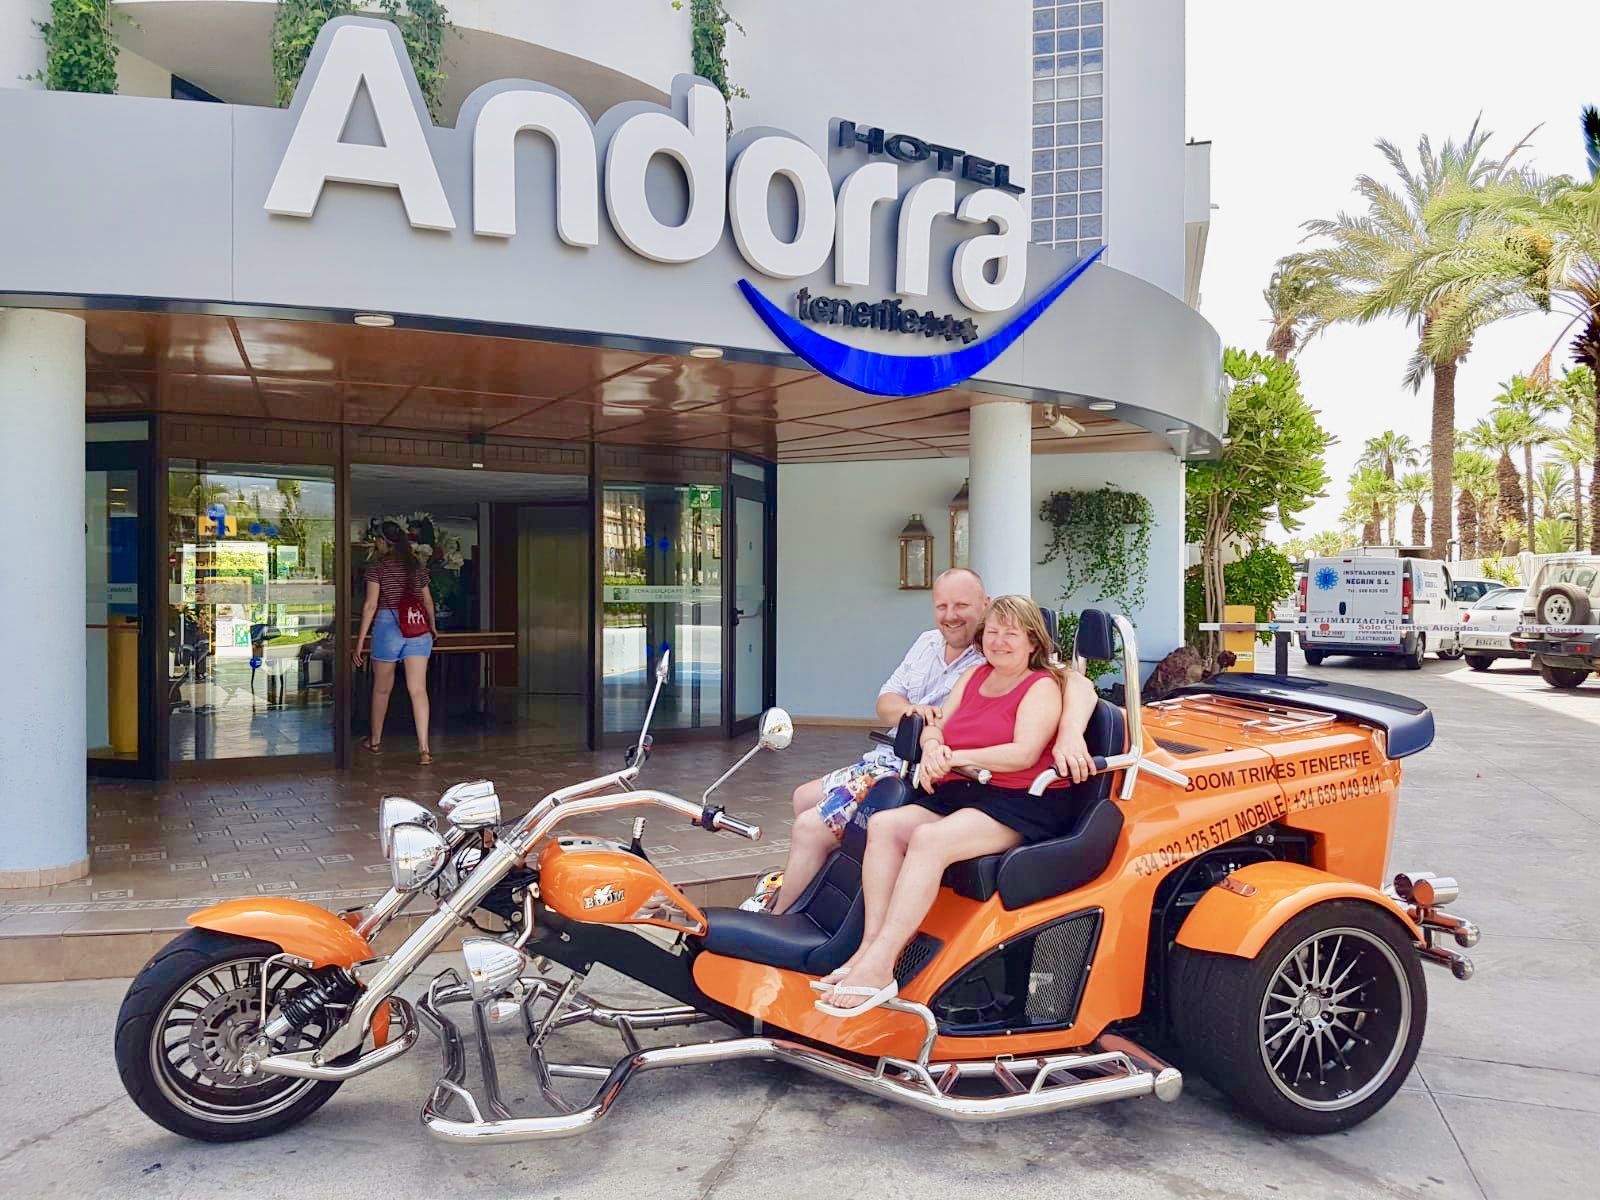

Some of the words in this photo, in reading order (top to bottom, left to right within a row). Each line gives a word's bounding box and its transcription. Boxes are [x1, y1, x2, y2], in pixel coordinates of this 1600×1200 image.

[264, 24, 1027, 312] Andorra
[838, 119, 1026, 195] HOTEL
[795, 286, 920, 334] tenerife
[1314, 616, 1396, 625] CLIMATIZACIÓN
[1432, 624, 1480, 632] Alojados
[1516, 625, 1541, 633] Only
[1185, 771, 1236, 792] BOOM
[1238, 762, 1296, 785] TRIKES
[1299, 750, 1372, 775] TENERIFE
[1134, 852, 1160, 876] +34
[1159, 841, 1186, 868] 922
[1185, 830, 1209, 856] 125
[1209, 818, 1232, 845] 577
[1293, 788, 1315, 810] +34
[1318, 783, 1338, 806] 659
[1340, 778, 1360, 800] 049
[1362, 773, 1382, 796] 841
